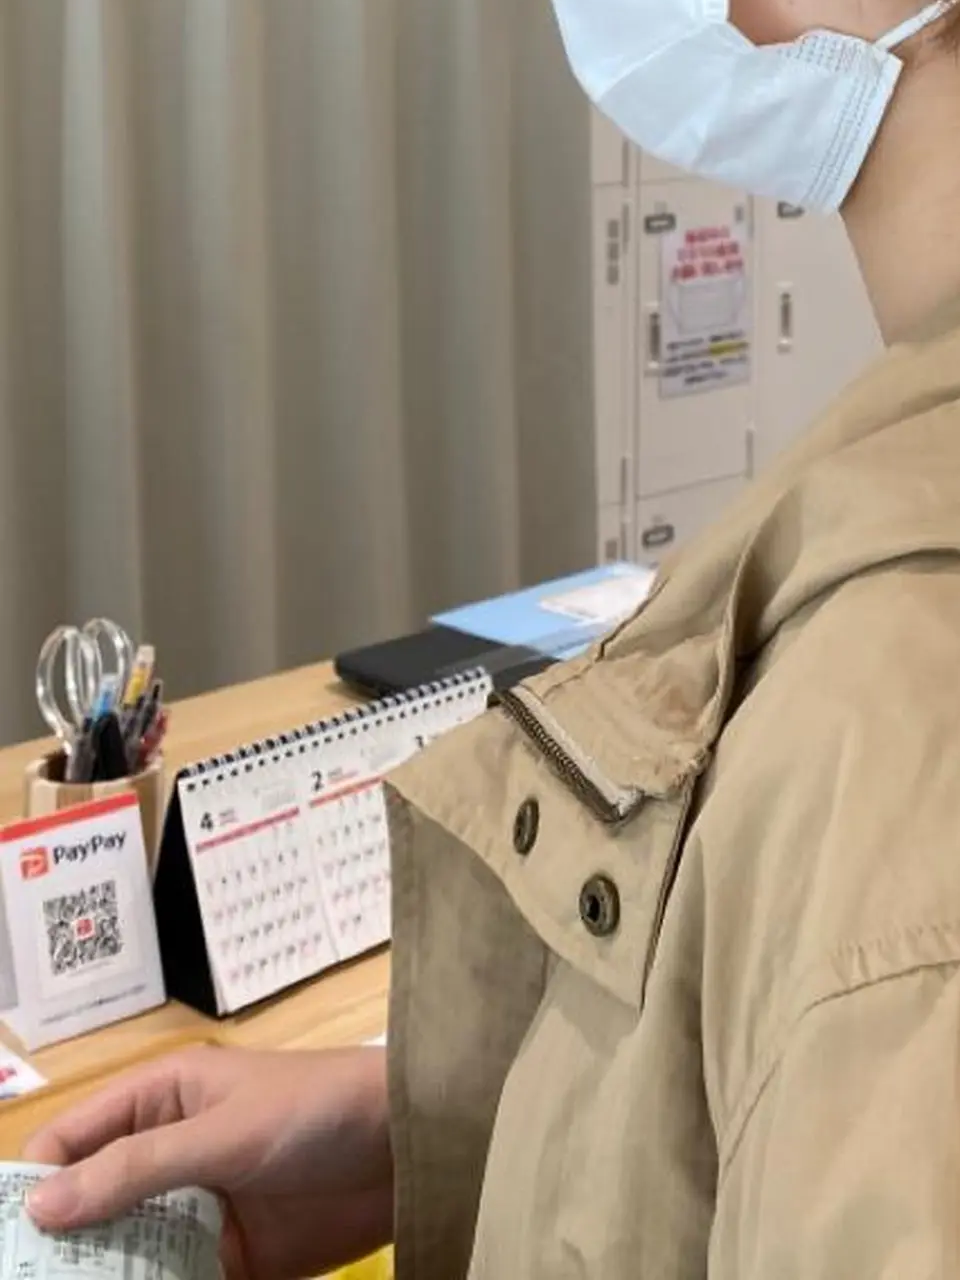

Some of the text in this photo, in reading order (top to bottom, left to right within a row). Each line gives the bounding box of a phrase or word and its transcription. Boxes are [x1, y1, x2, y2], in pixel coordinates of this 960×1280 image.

[311, 770, 324, 792] 2
[199, 811, 213, 832] 4
[53, 831, 126, 865] PayPay
